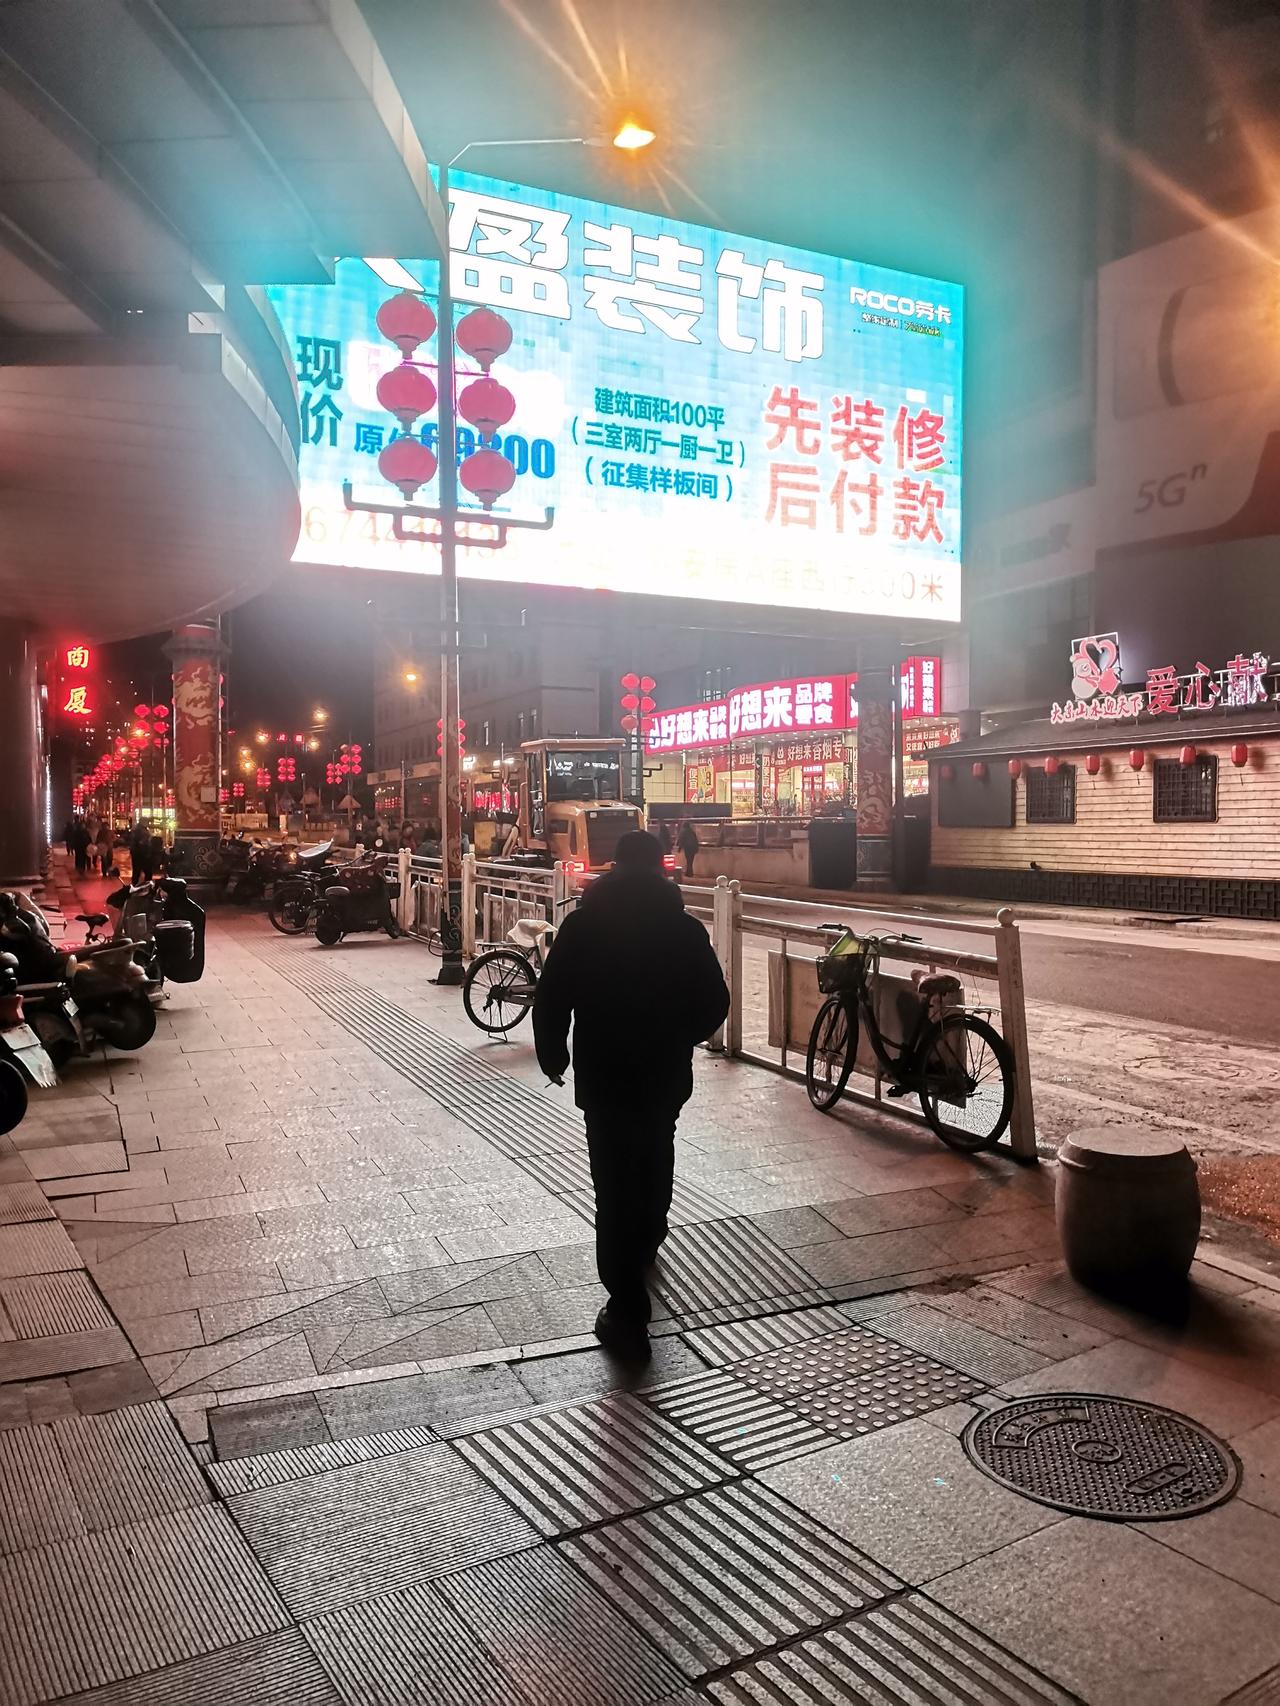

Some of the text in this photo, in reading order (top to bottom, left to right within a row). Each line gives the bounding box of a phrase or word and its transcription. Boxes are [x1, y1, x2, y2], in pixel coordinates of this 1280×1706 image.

[336, 187, 825, 363] 盈装饰
[594, 386, 726, 432] 建筑面积100平
[764, 386, 946, 472] 先装修
[764, 462, 945, 544] 后付款
